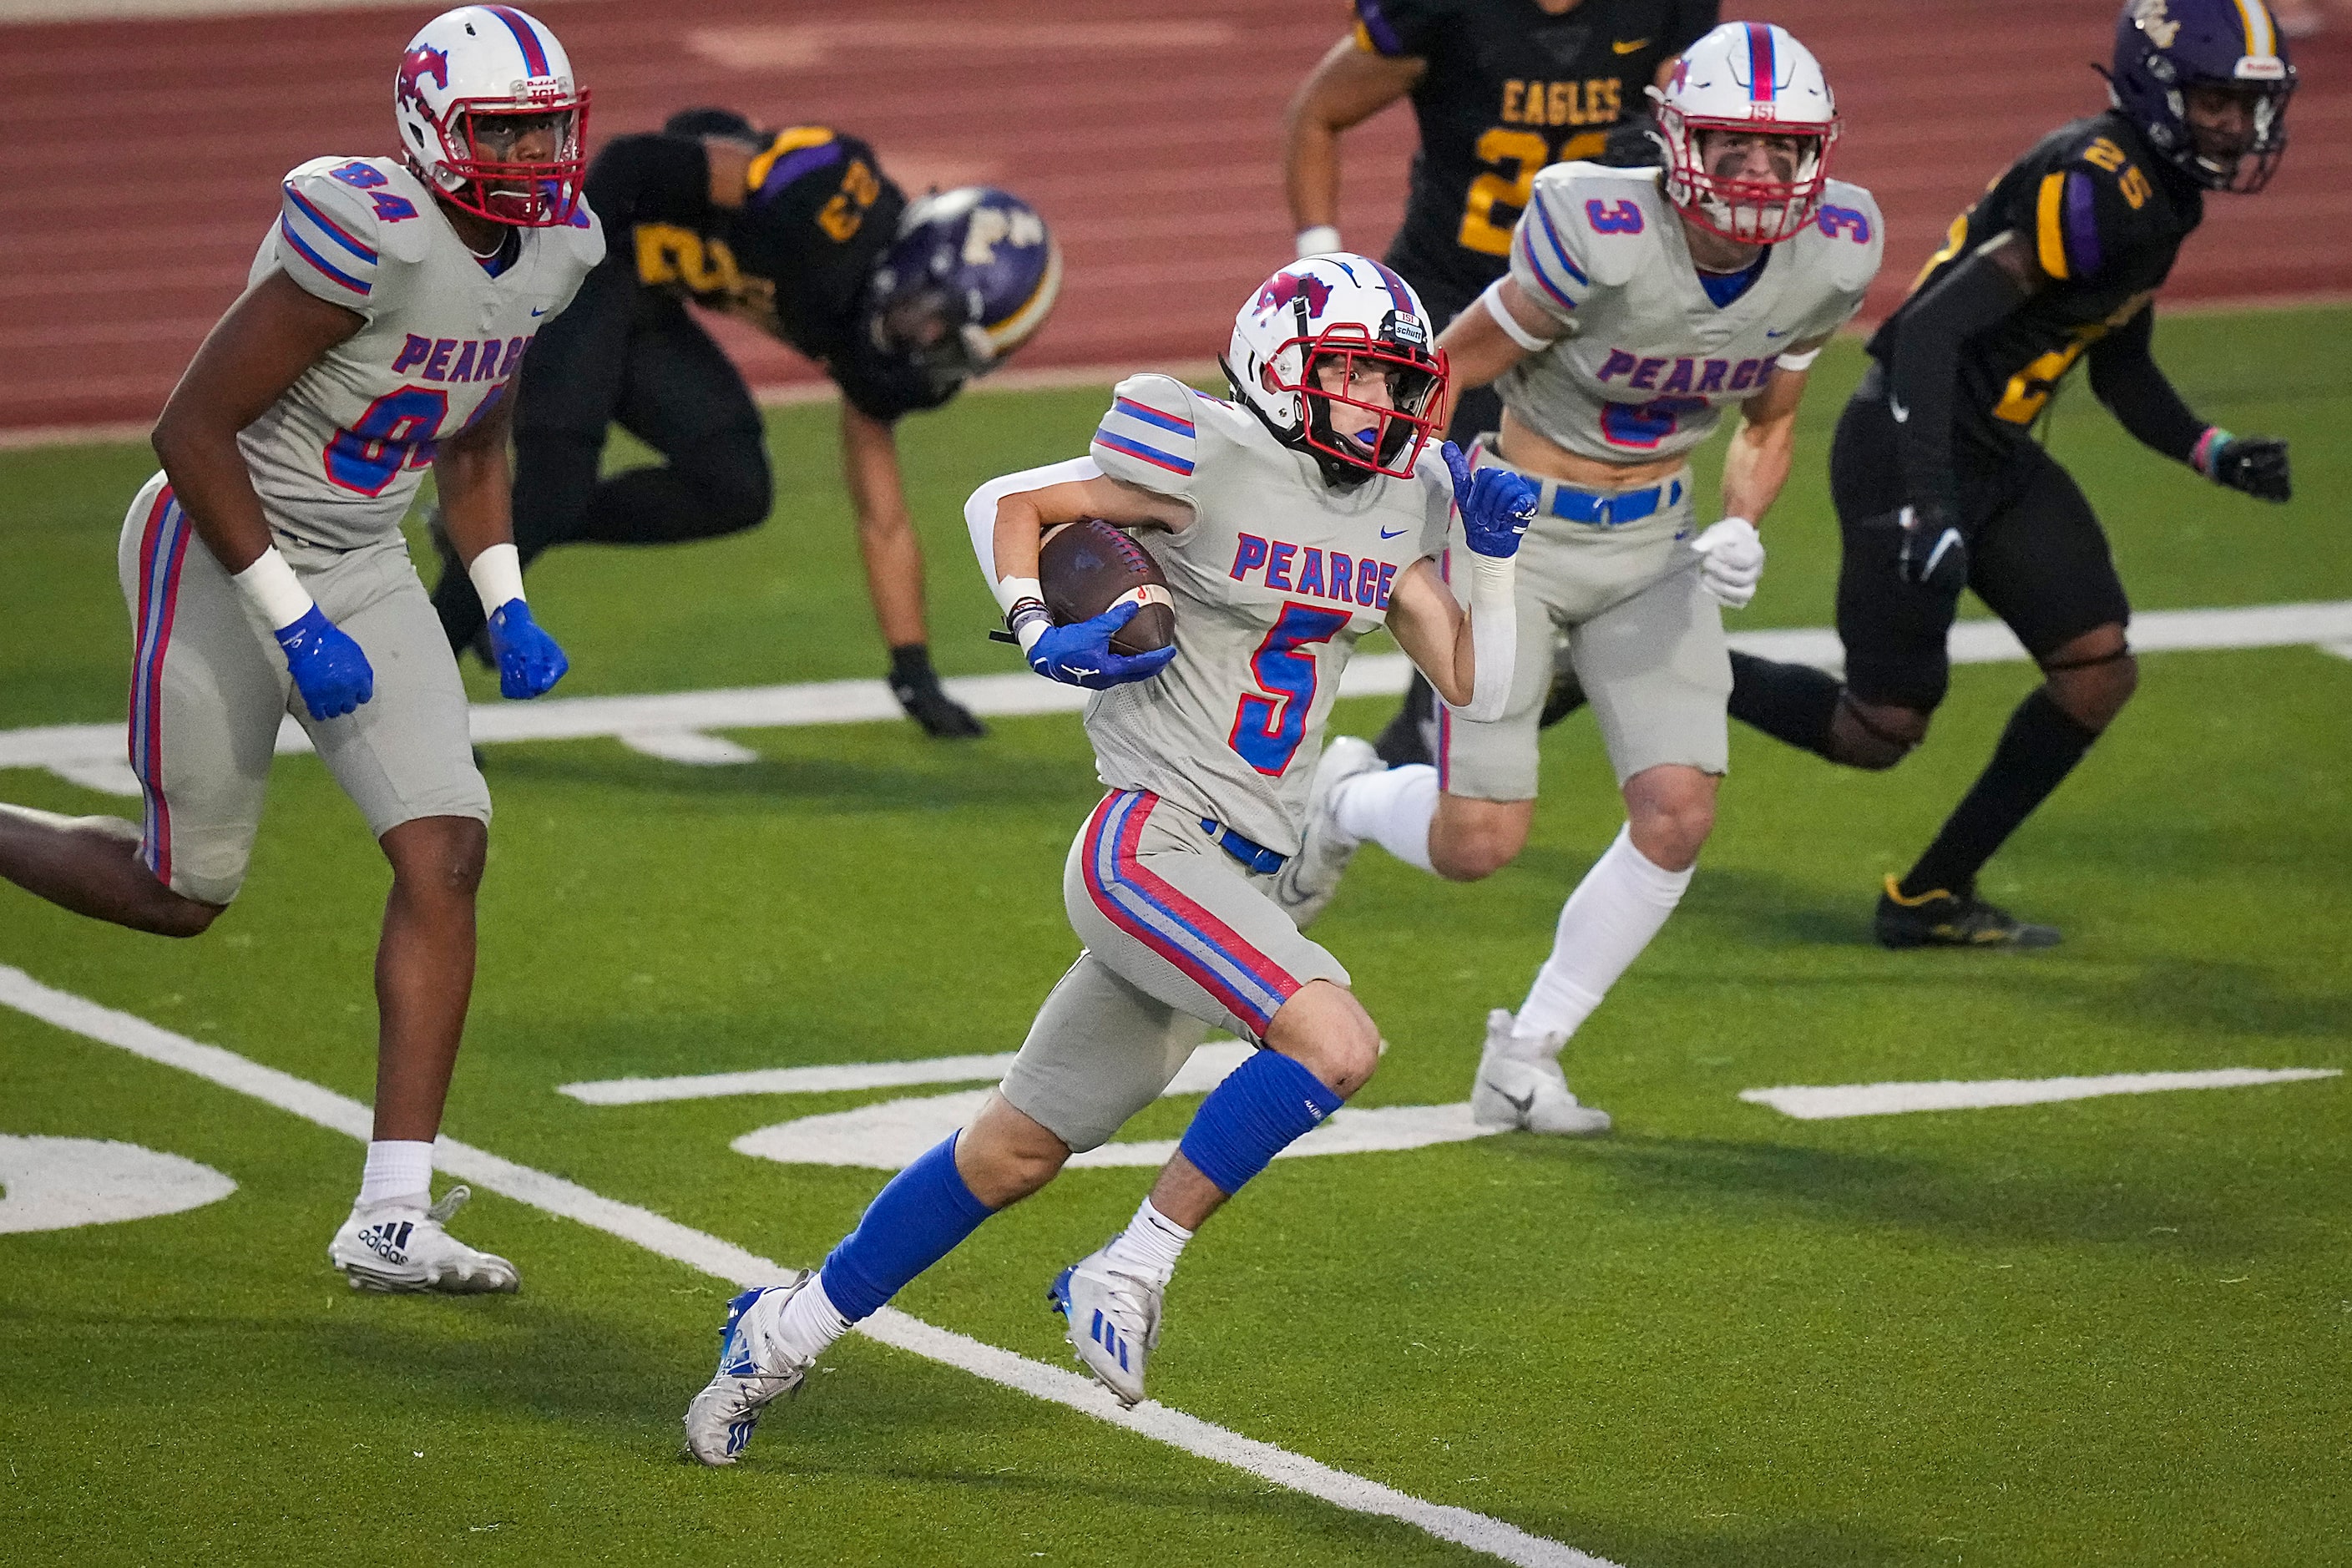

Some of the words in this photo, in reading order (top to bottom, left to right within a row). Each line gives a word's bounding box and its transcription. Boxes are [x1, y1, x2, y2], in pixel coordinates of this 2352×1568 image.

[1502, 78, 1621, 125] EAGLES
[330, 162, 419, 223] 84
[1459, 128, 1610, 256] 2
[2083, 136, 2152, 210] 25
[1586, 199, 1645, 235] 3
[1818, 204, 1871, 244] 3
[1396, 326, 1422, 340] schutt
[1402, 312, 1414, 323] ISI
[391, 333, 537, 382] PEARC
[1228, 531, 1398, 611] PEARCE
[1228, 600, 1353, 777] 5
[358, 1229, 408, 1267] adidas
